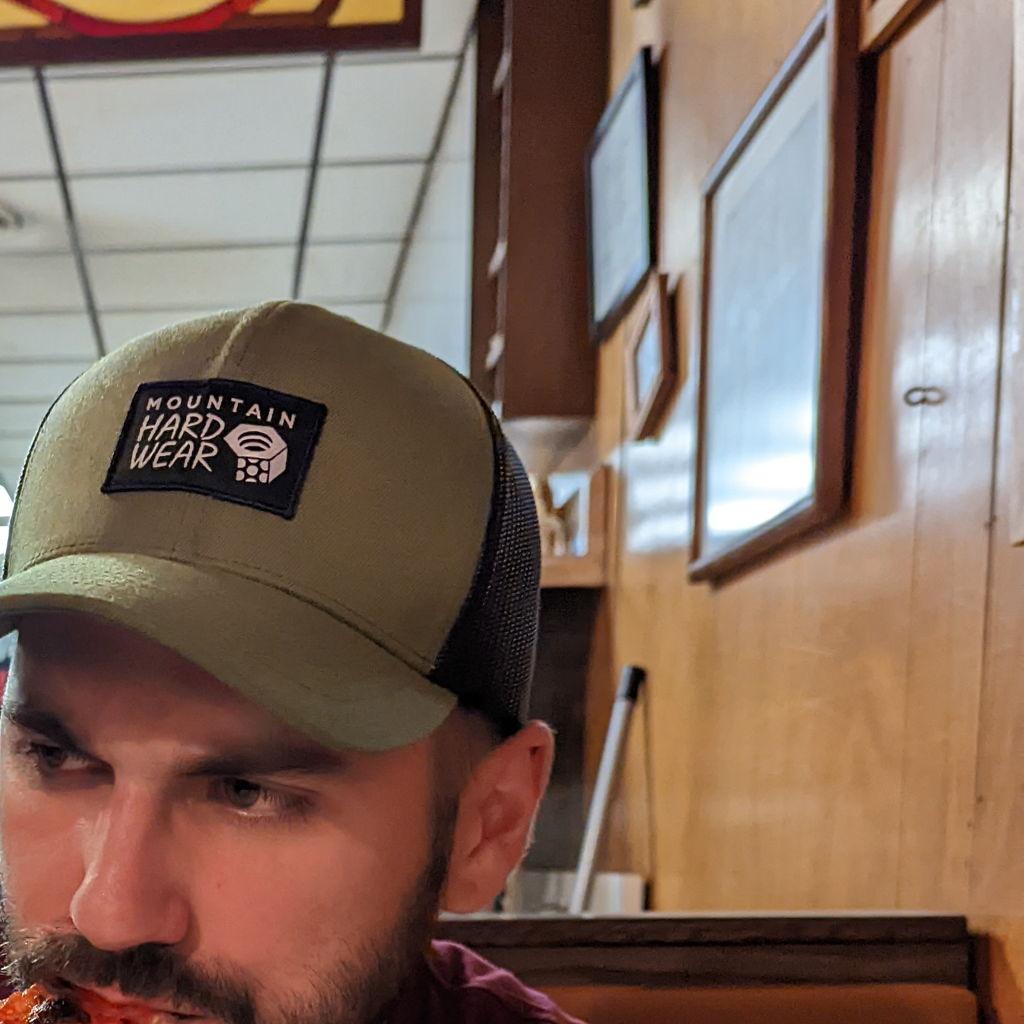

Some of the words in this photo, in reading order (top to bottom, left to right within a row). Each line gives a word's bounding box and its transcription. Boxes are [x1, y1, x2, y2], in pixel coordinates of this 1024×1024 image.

[137, 413, 226, 443] HARD
[145, 395, 297, 429] MOUNTAIN
[129, 440, 219, 473] WEAR
